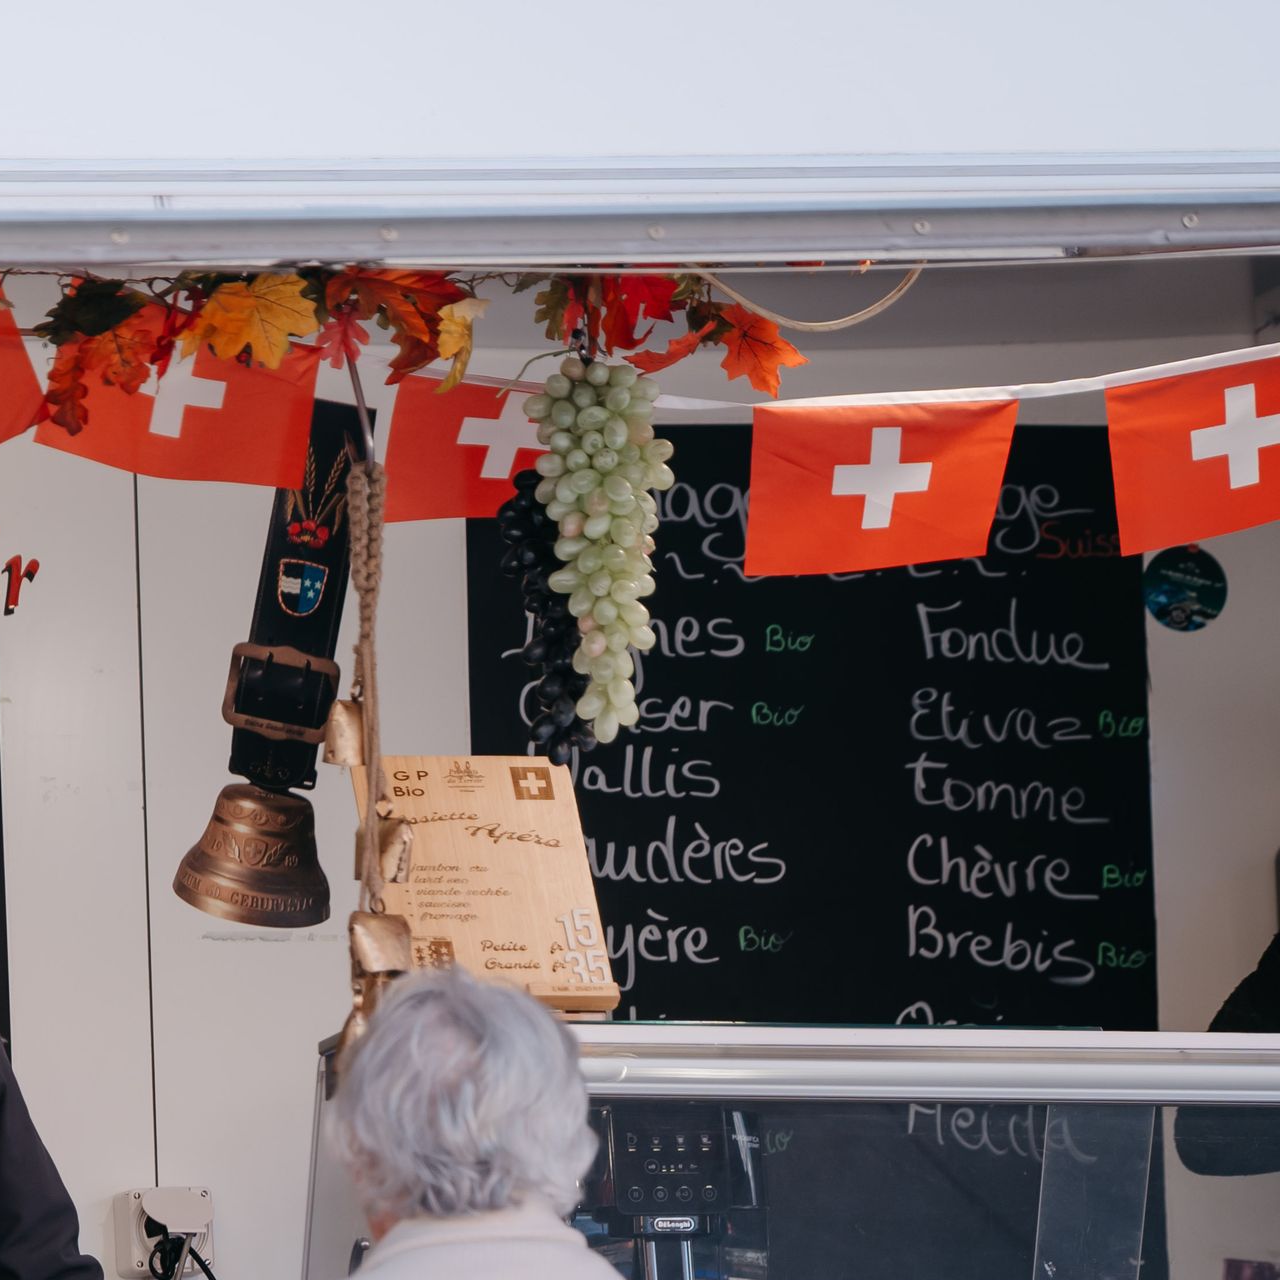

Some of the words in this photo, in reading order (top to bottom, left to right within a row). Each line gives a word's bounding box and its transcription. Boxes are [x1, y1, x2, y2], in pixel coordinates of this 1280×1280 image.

[766, 624, 816, 653] Bio
[916, 597, 1110, 670] Fondue
[751, 704, 805, 729] Bio
[1098, 710, 1146, 738] Bio
[393, 786, 425, 798] Bio
[395, 812, 480, 825] ssiette
[465, 822, 562, 849] Apéro
[907, 833, 1100, 899] Chèvre
[1102, 862, 1147, 889] Bio
[416, 887, 462, 897] viande
[420, 911, 479, 922] fromage
[481, 939, 528, 953] Petite
[555, 907, 598, 951] 15
[739, 926, 792, 951] Bio
[907, 904, 1096, 985] Brebis
[1097, 941, 1150, 968] Bio
[485, 957, 542, 971] Grande
[563, 950, 610, 984] 35
